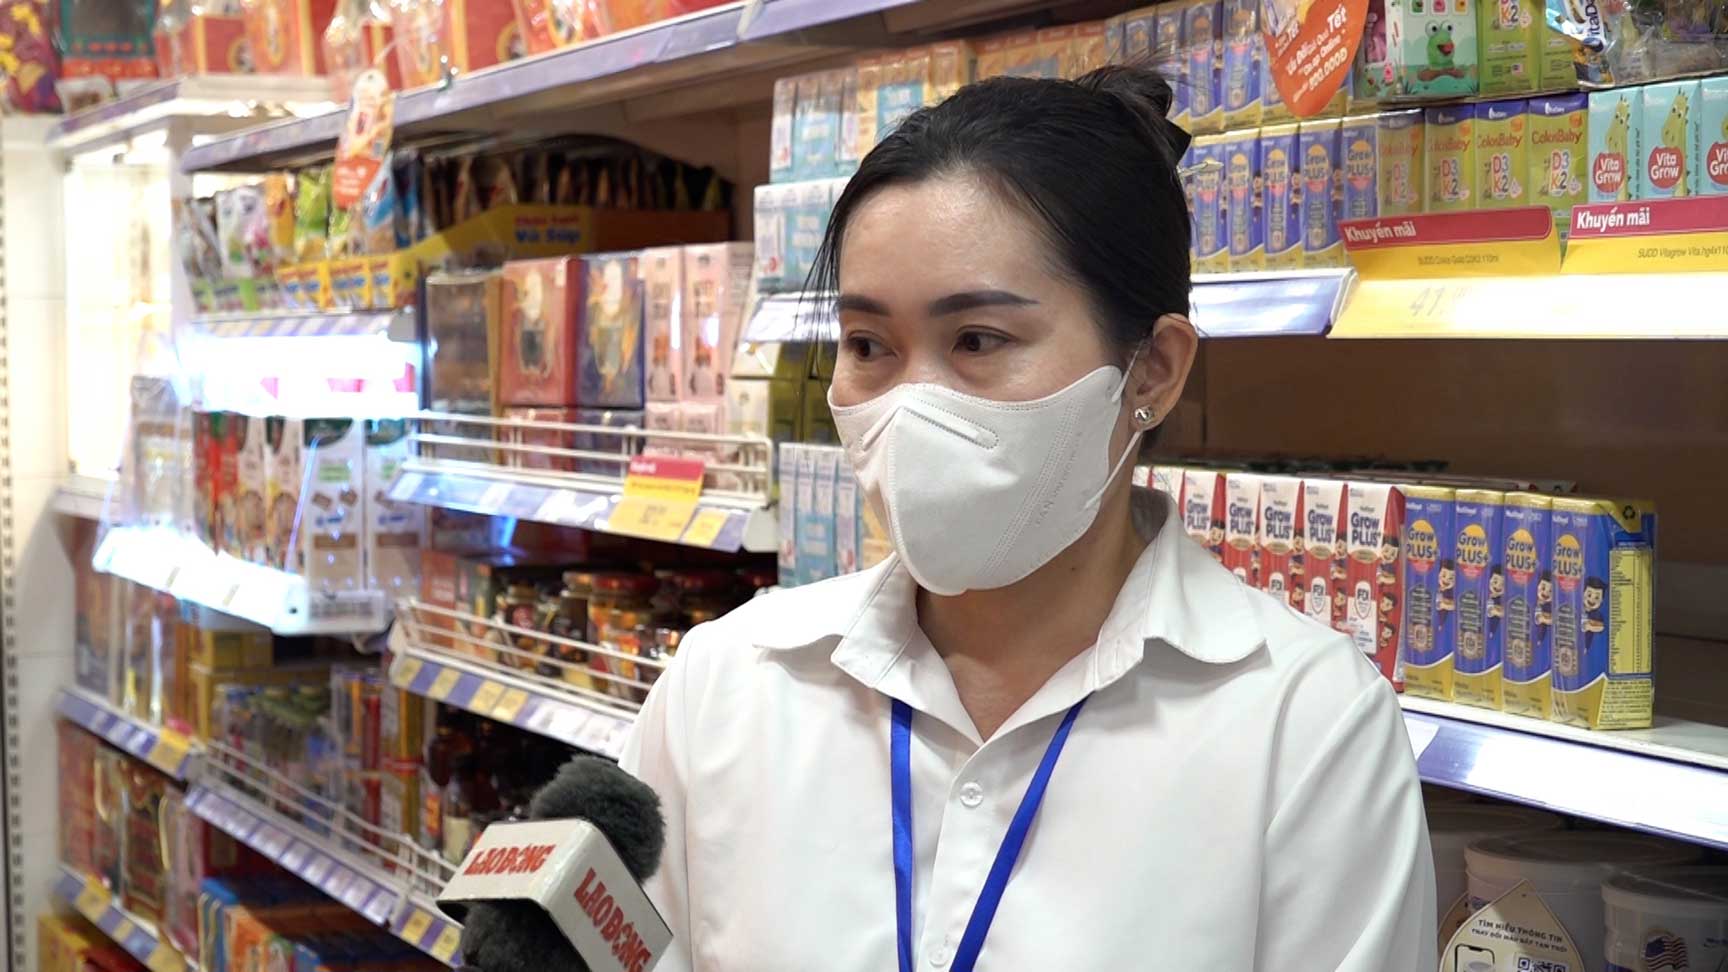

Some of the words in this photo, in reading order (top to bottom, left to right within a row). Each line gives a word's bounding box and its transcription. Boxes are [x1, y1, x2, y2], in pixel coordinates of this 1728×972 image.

[1327, 3, 1347, 33] Tết
[1492, 155, 1509, 174] D3
[1552, 151, 1570, 170] D3
[1600, 158, 1619, 171] Vita
[1656, 152, 1677, 166] Vita
[1551, 170, 1568, 190] K2
[1595, 170, 1622, 185] Grow
[1650, 165, 1680, 180] Grow
[1493, 174, 1509, 193] K2
[1576, 206, 1624, 233] Khuyến
[1626, 207, 1650, 226] mãi
[1344, 221, 1393, 243] Khuyến
[1393, 221, 1417, 237] mãi
[1229, 502, 1253, 518] Grow
[1265, 506, 1291, 522] Grow
[1308, 508, 1334, 526] Grow
[1351, 512, 1380, 530] Grow
[1408, 526, 1434, 541] Grow
[1458, 531, 1487, 547] Grow
[1508, 536, 1534, 552] Grow
[1555, 543, 1581, 559] Grow
[1506, 553, 1537, 570] PLUS+
[1517, 926, 1548, 941] THÔNG
[1548, 933, 1563, 943] TIN
